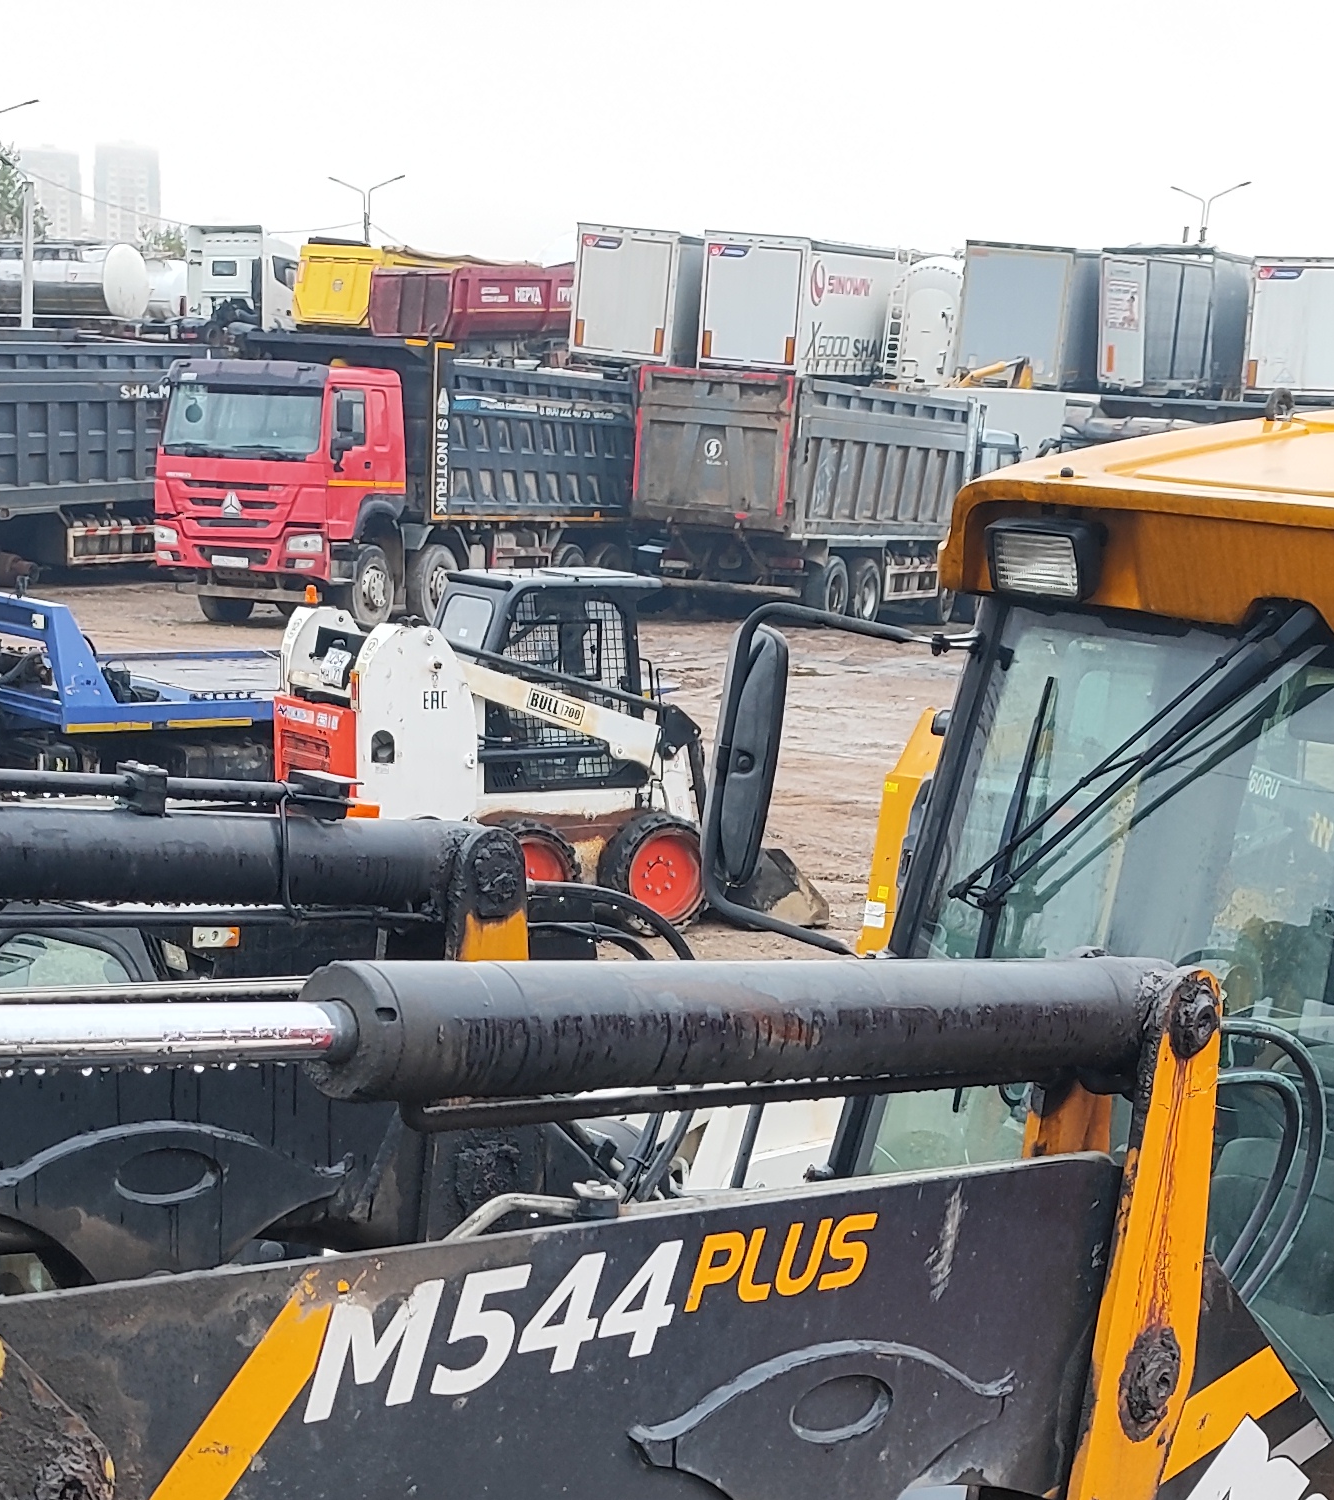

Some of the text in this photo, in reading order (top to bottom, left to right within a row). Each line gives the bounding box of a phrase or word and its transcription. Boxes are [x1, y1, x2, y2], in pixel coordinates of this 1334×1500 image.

[435, 418, 449, 514] SINOTRUK
[423, 690, 448, 710] EAC
[530, 692, 559, 715] BULL
[303, 1212, 879, 1424] M544 PLUS
